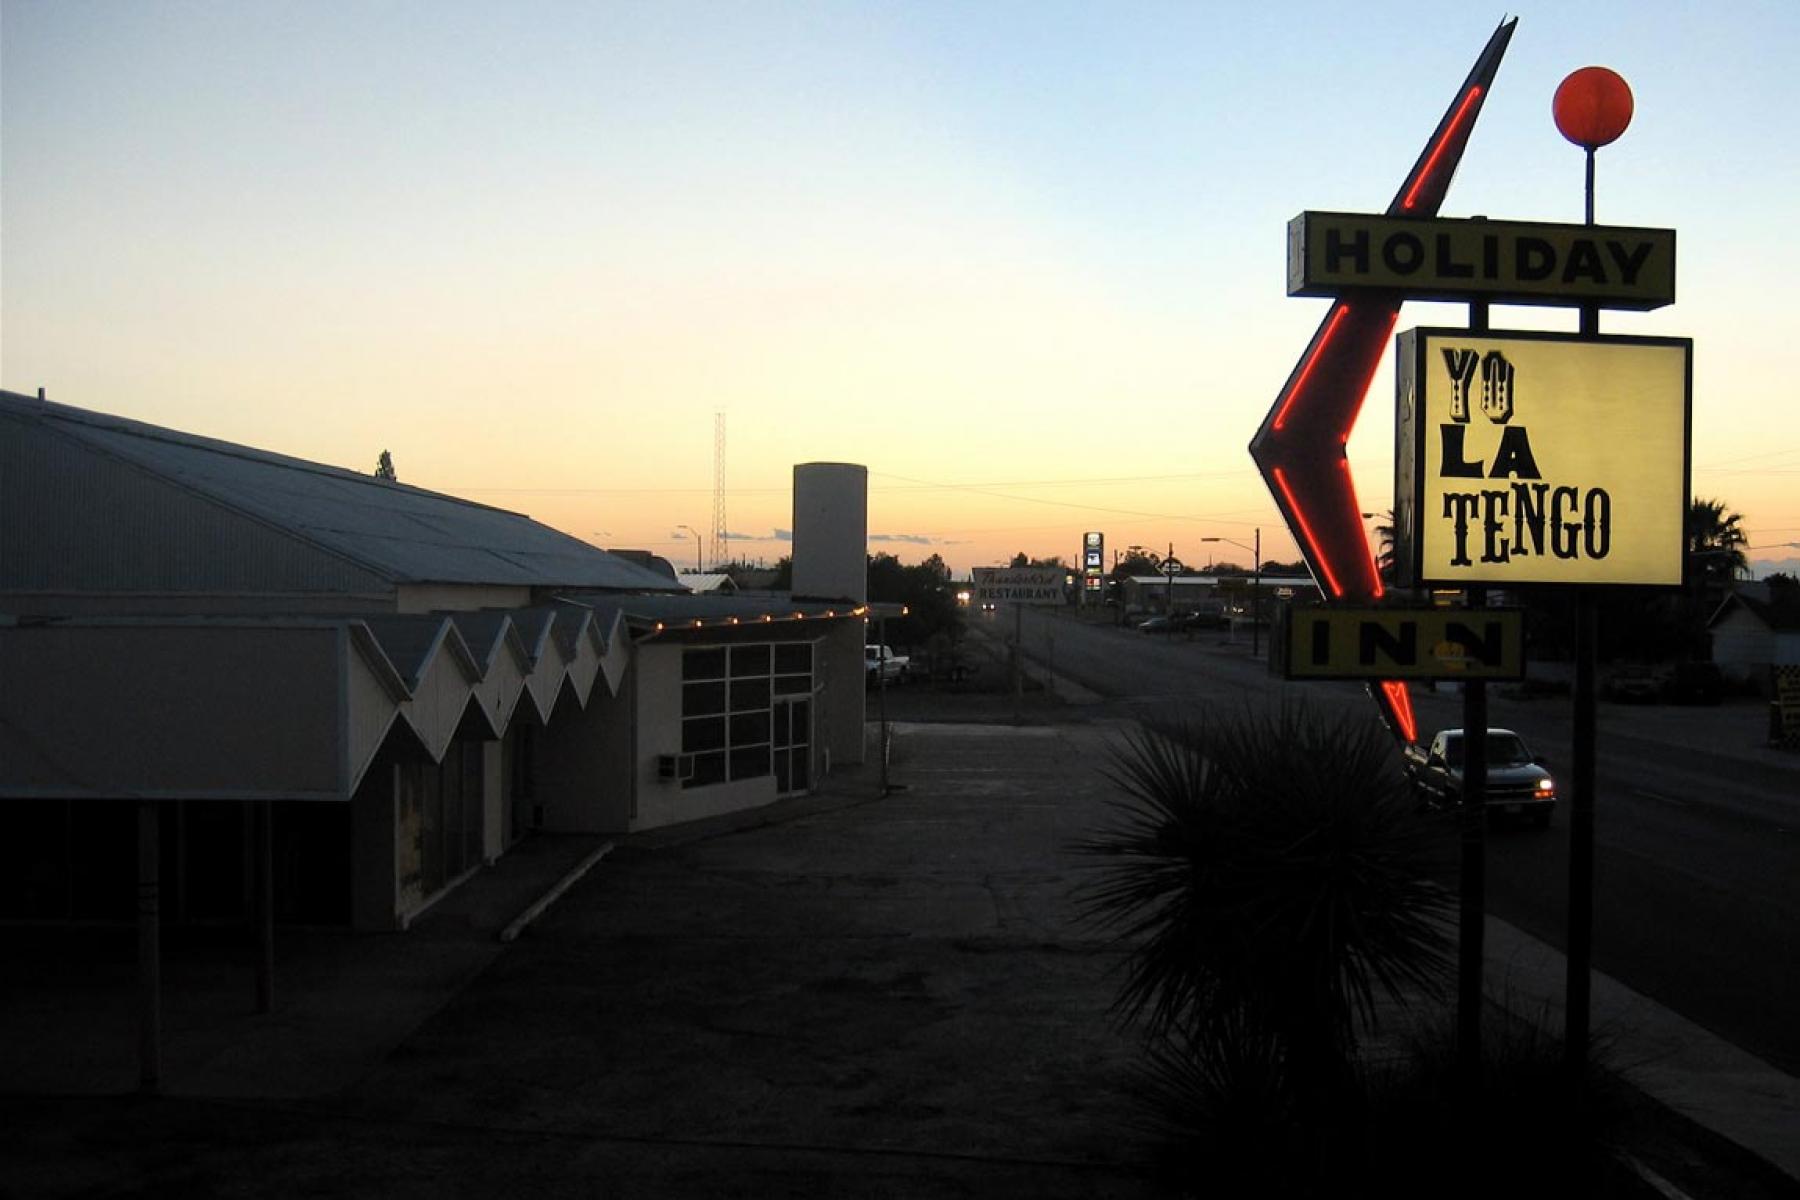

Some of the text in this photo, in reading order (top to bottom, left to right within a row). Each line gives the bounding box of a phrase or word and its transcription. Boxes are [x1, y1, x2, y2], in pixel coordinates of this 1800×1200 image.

[1325, 229, 1654, 284] HOLIDAY
[1440, 348, 1514, 424] YO
[1439, 424, 1542, 479] LA
[1443, 482, 1610, 566] TENGO
[980, 587, 1058, 599] RESTAURANT
[1313, 621, 1501, 665] INN
